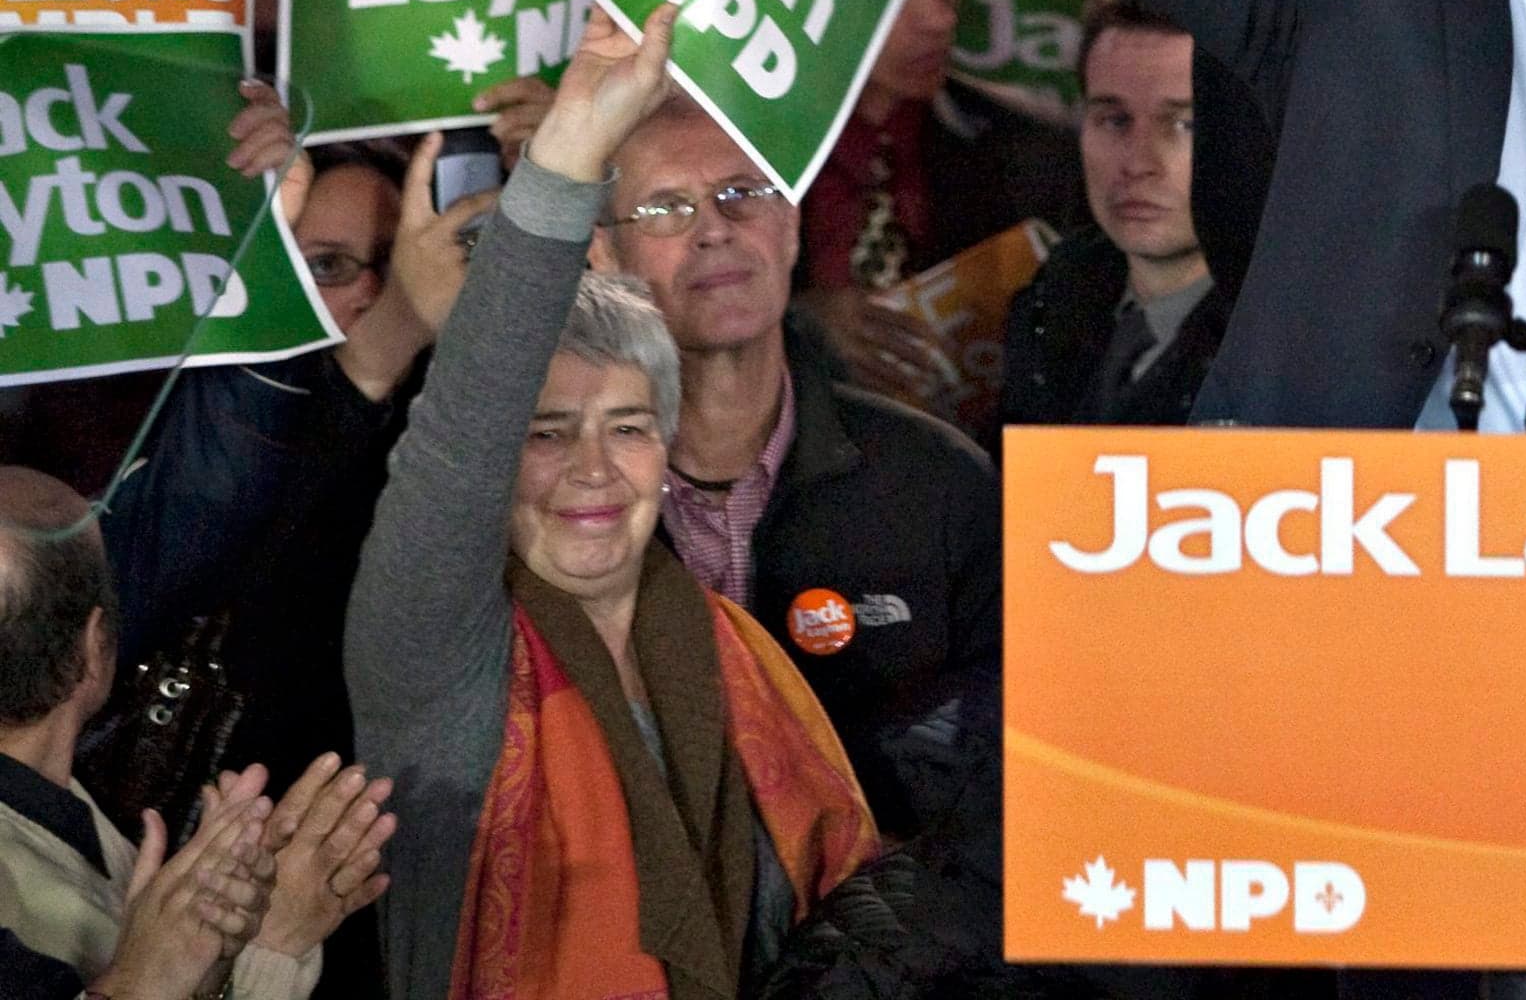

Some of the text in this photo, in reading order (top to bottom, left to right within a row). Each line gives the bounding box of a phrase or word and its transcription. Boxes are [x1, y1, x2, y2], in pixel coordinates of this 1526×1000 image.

[0, 155, 233, 267] yton
[42, 252, 248, 331] NPD
[1048, 454, 1420, 577] Jack
[794, 599, 849, 633] Jack
[1143, 859, 1366, 934] NPD
